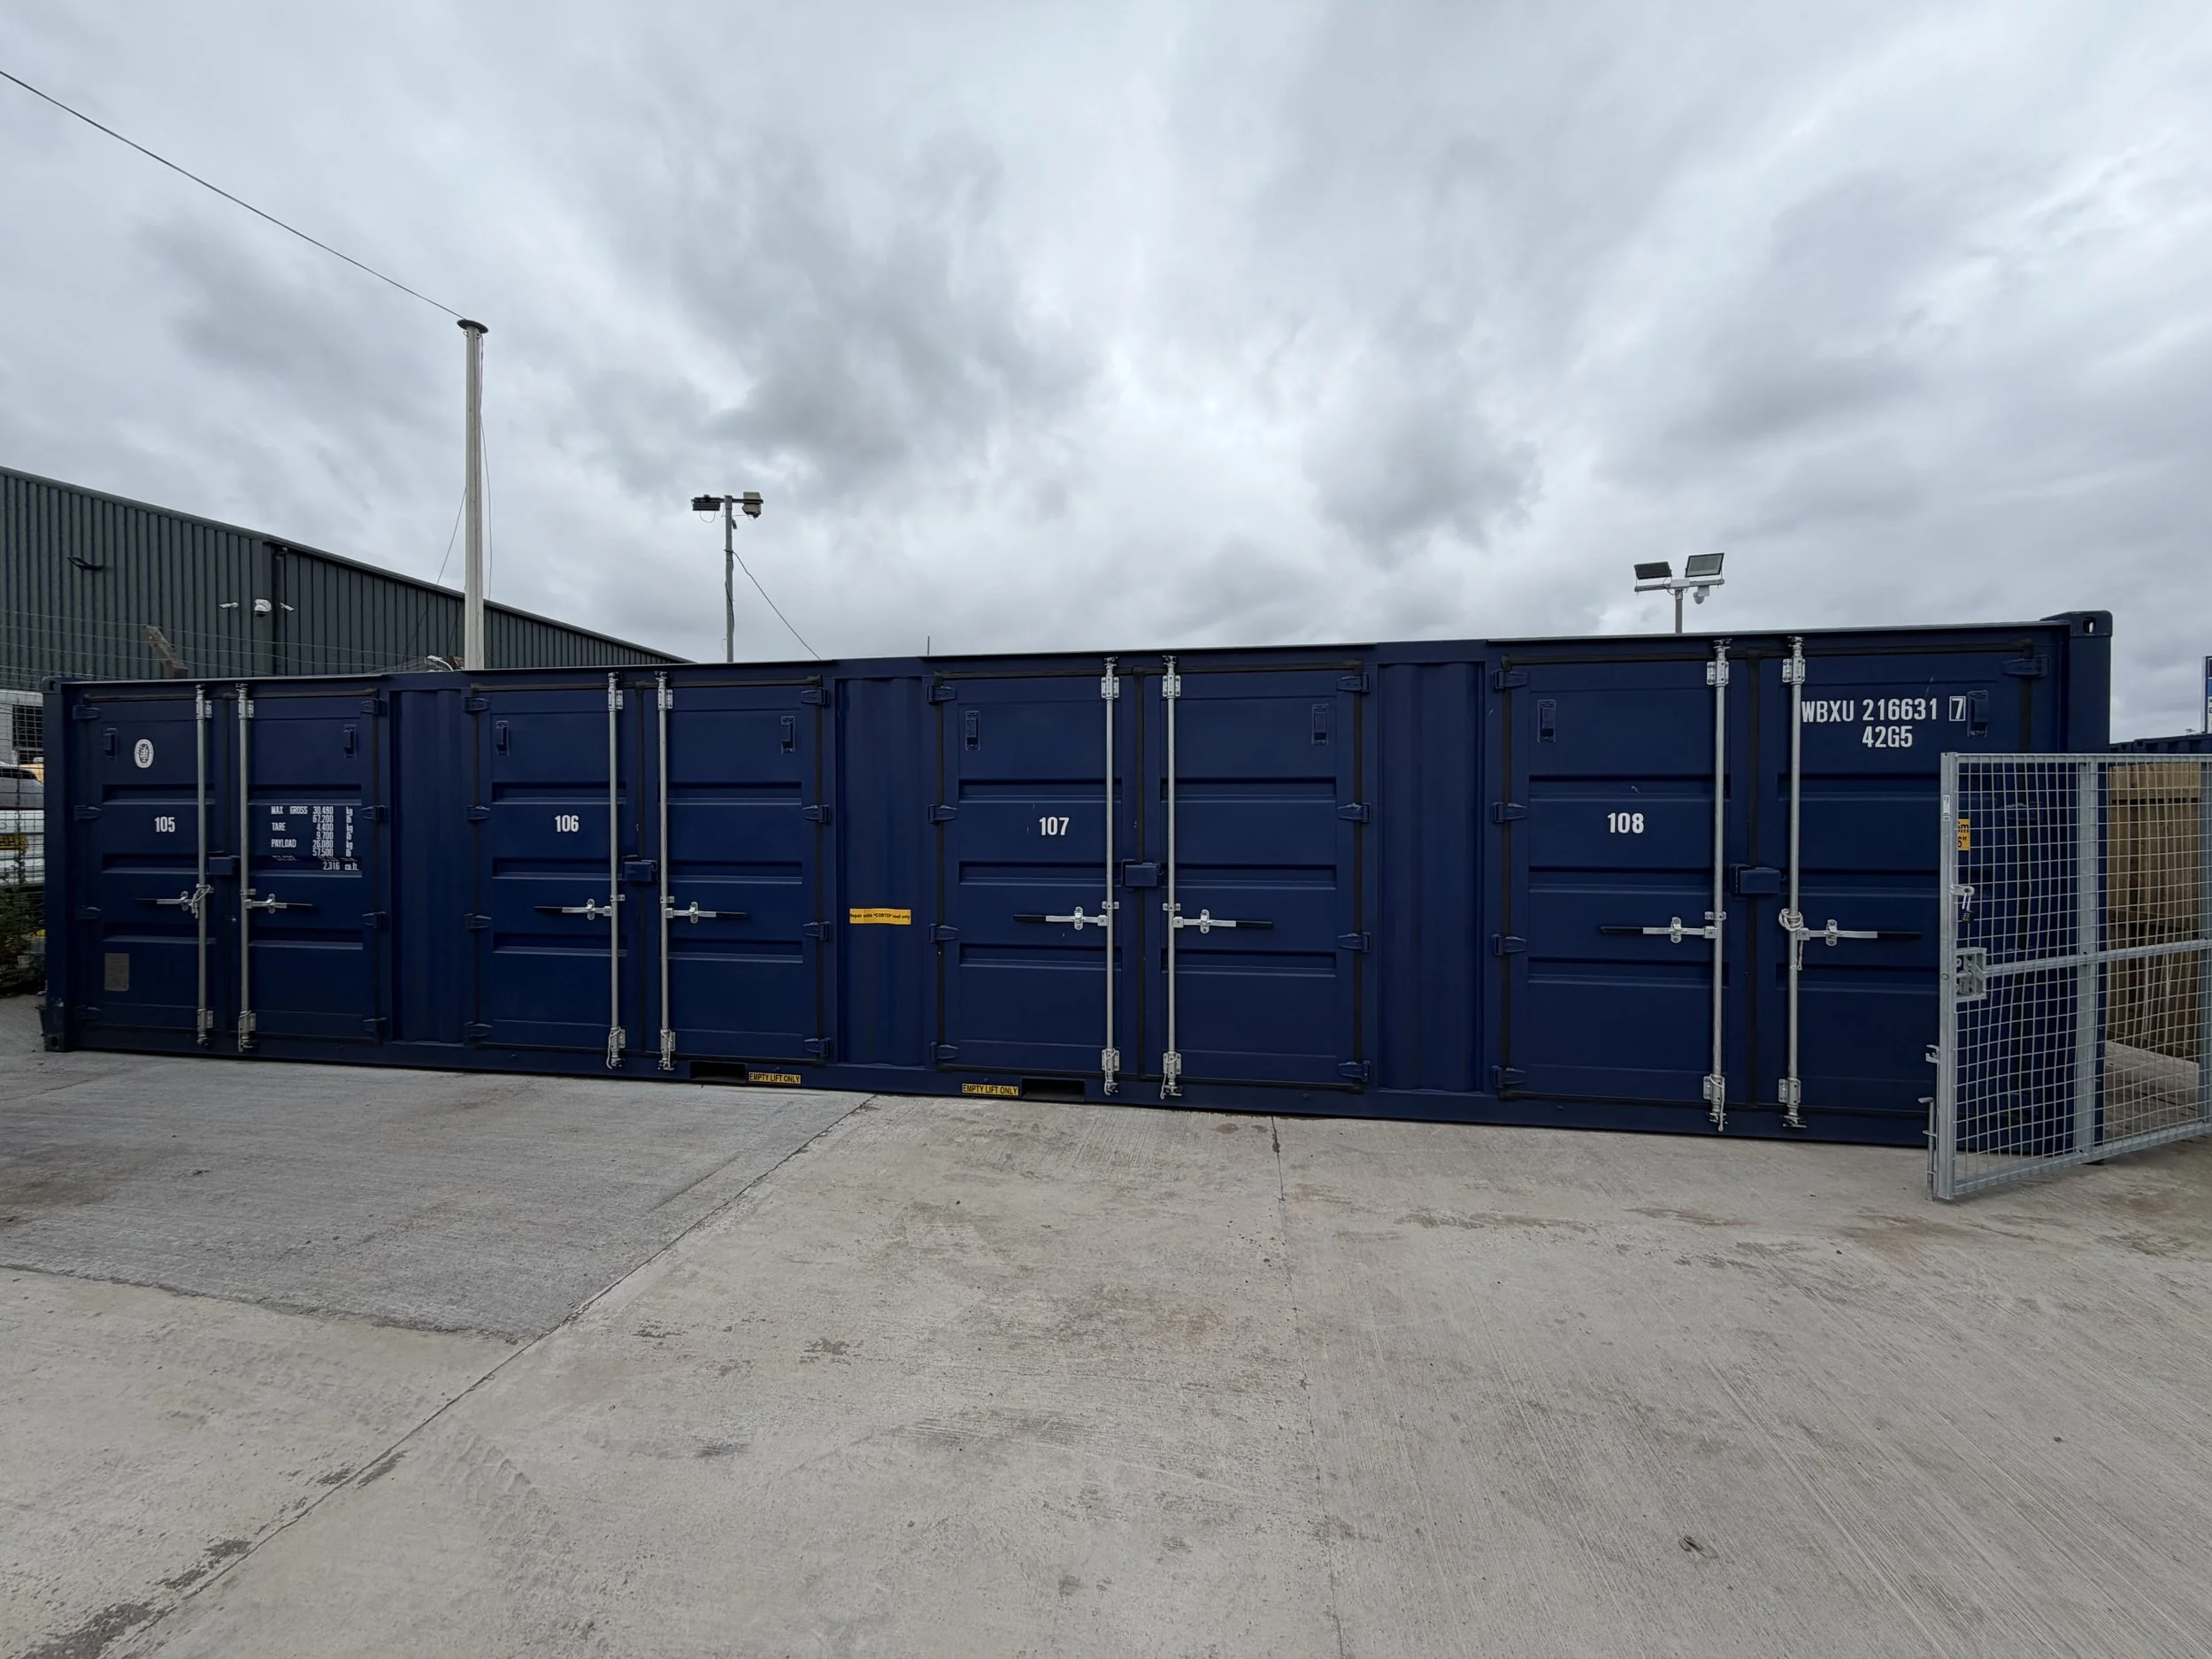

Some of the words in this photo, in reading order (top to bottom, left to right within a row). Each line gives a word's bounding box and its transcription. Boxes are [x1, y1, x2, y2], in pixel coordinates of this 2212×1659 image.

[1801, 700, 1855, 723] WBXU
[1862, 698, 1937, 721] 216631
[1950, 697, 1965, 720] 7
[1862, 726, 1913, 748] 42G5
[154, 816, 175, 833] 105
[272, 822, 286, 831] TARE
[555, 815, 580, 833] 106
[1039, 817, 1070, 835] 107
[1607, 812, 1644, 833] 108
[271, 839, 296, 848] PAYLOAD
[963, 1084, 984, 1093] EMPTY
